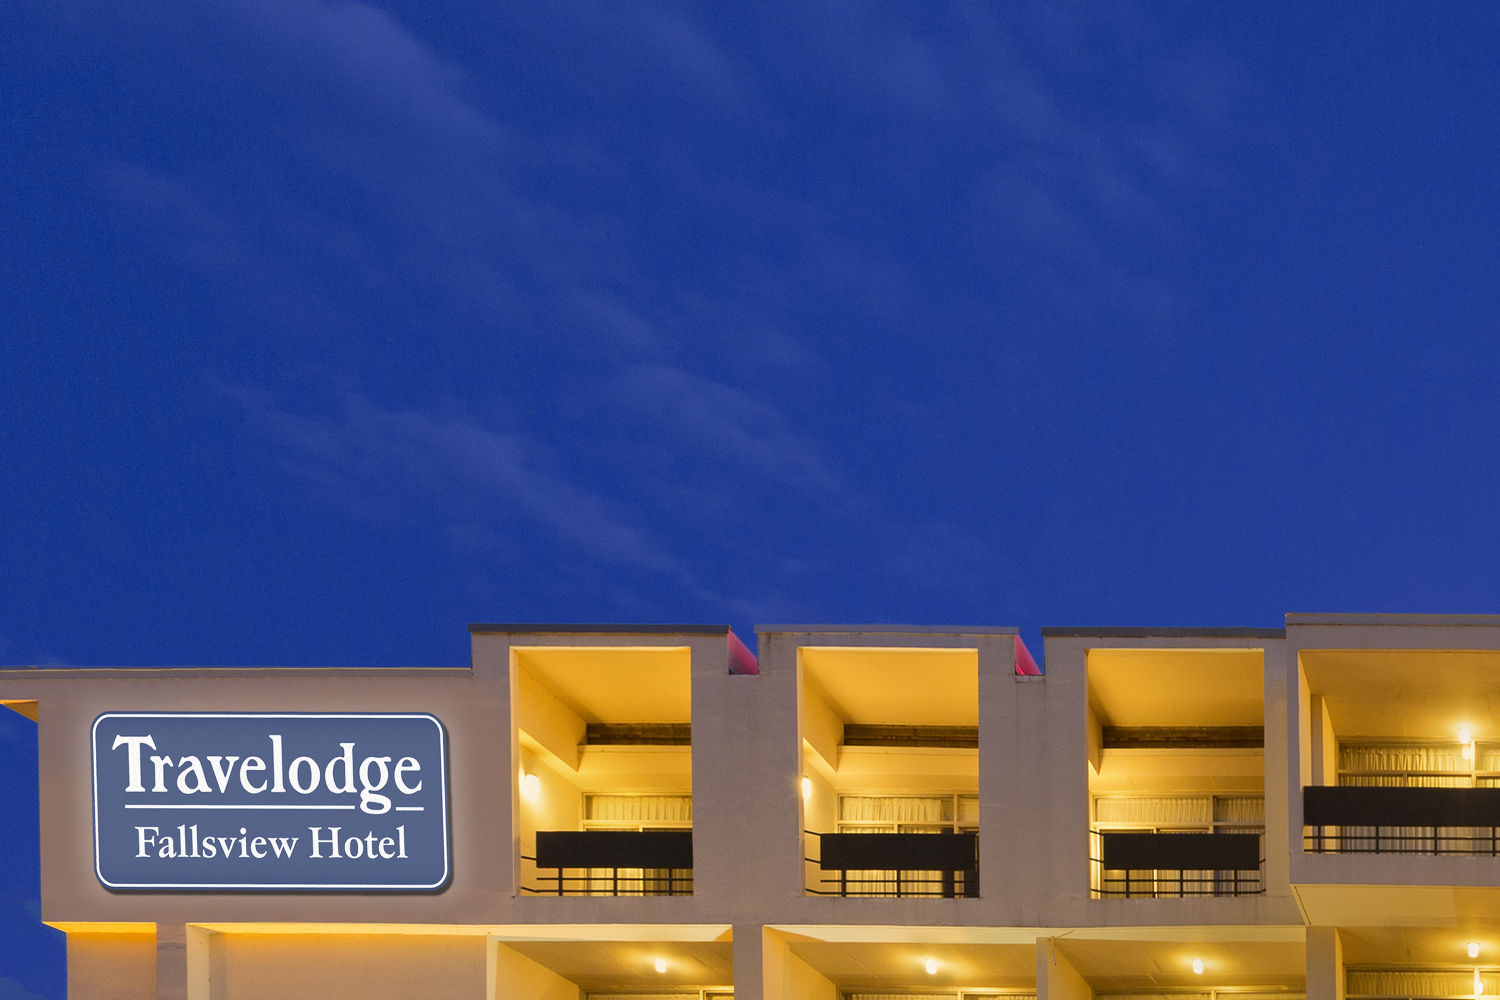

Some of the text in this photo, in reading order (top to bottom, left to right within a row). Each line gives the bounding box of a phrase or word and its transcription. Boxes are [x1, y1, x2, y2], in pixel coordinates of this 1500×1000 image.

[112, 734, 422, 815] Travelodge
[134, 824, 408, 859] Fallsview Hotel
